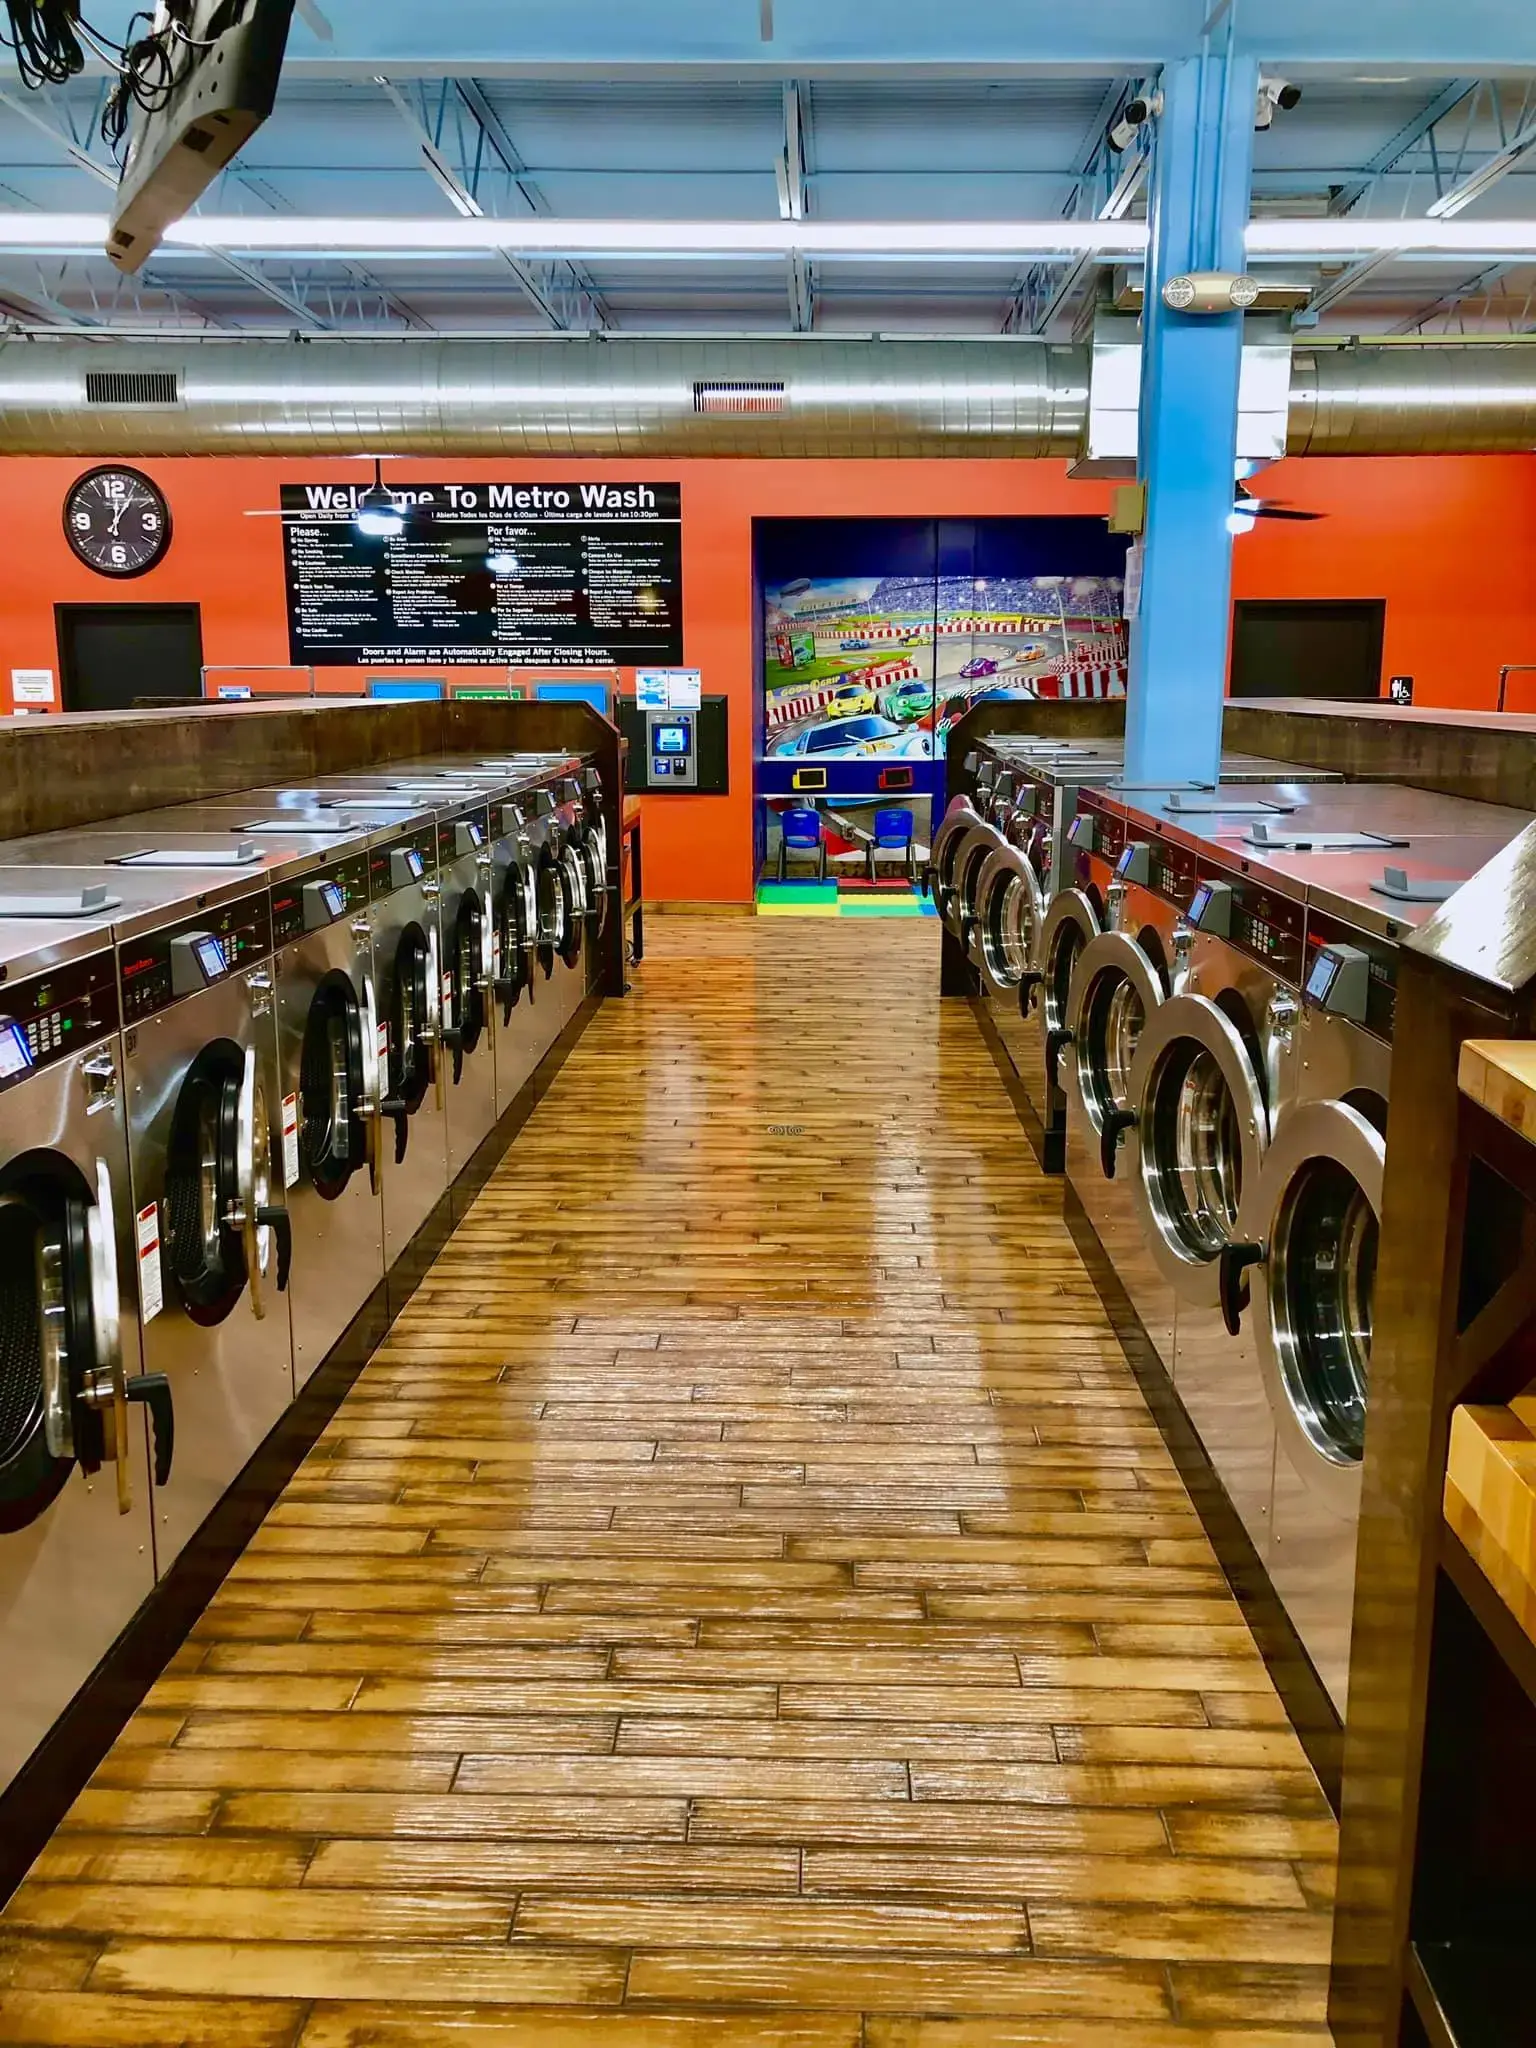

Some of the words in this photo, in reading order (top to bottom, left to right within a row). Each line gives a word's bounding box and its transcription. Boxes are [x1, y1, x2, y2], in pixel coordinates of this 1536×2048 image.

[102, 480, 125, 498] 12
[305, 486, 435, 509] Welme
[443, 485, 478, 509] To
[488, 485, 570, 508] Metro
[579, 485, 656, 508] Wash
[76, 513, 91, 530] 9
[142, 513, 157, 531] 3
[289, 526, 330, 537] Please...
[487, 526, 503, 536] Por
[505, 525, 537, 536] favor...
[111, 545, 126, 563] 6
[363, 648, 385, 656] Doors
[386, 648, 402, 656] and
[403, 648, 427, 656] Alarm
[428, 648, 441, 656] are
[442, 648, 496, 656] Automatically
[497, 648, 531, 656] Engaged
[533, 648, 552, 656] After
[553, 648, 583, 656] Closing
[584, 648, 610, 656] Hours.
